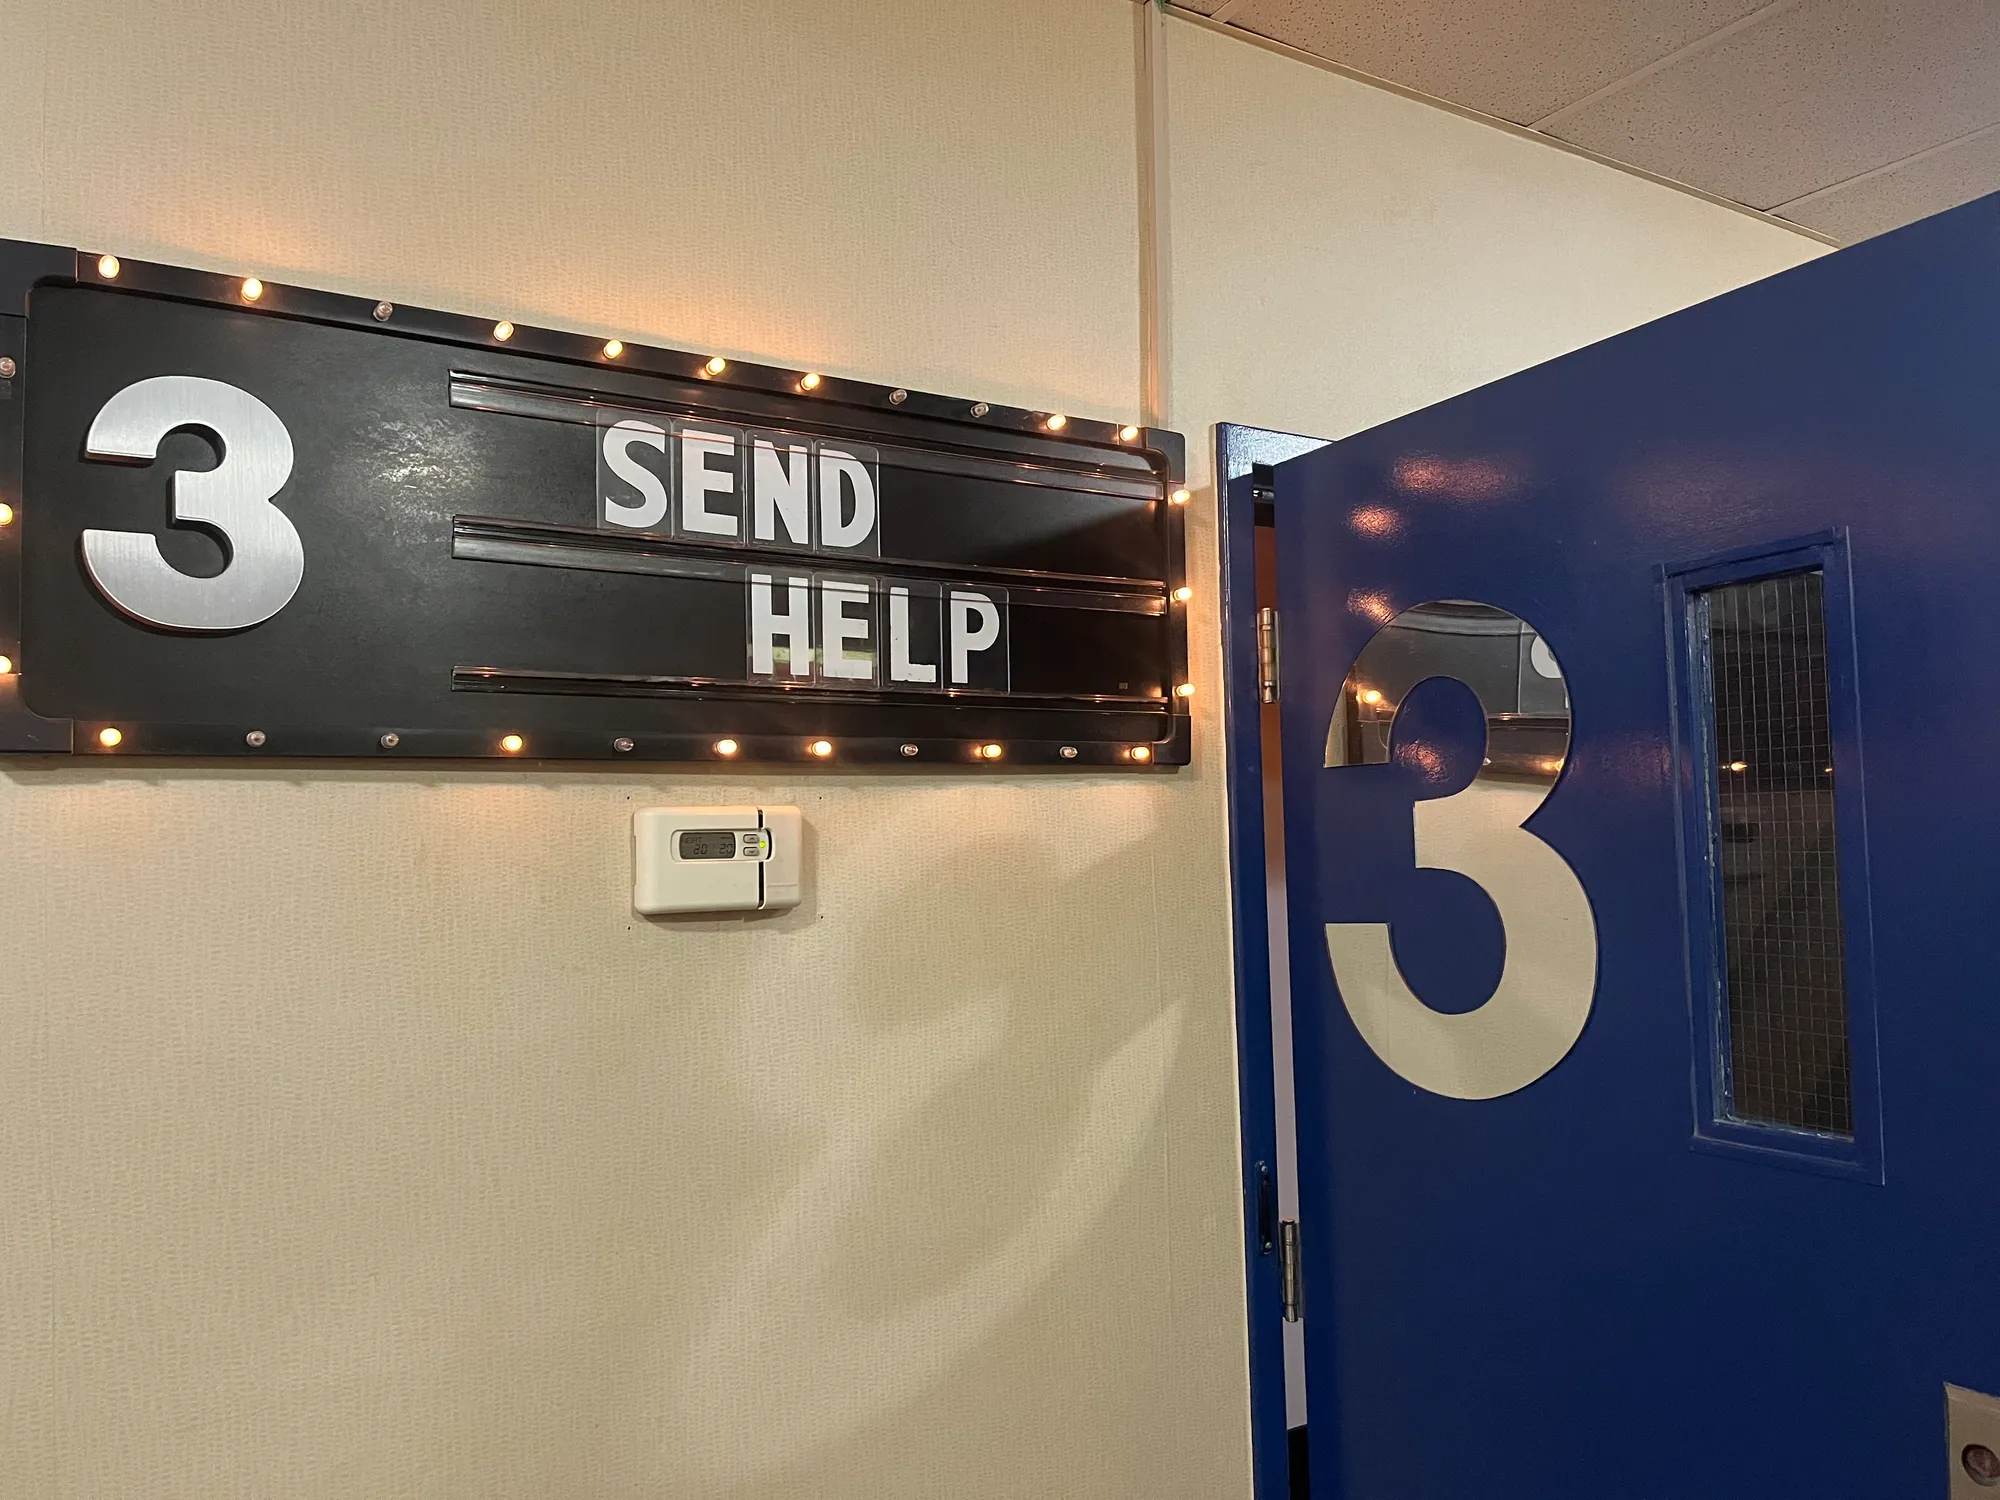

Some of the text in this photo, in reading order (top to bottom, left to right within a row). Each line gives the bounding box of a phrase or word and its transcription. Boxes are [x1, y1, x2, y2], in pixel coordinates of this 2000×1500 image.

[83, 375, 304, 630] 3
[603, 420, 876, 548] SEND
[751, 574, 1001, 684] HELP
[693, 843, 708, 855] 20
[1324, 600, 1598, 1100] 3
